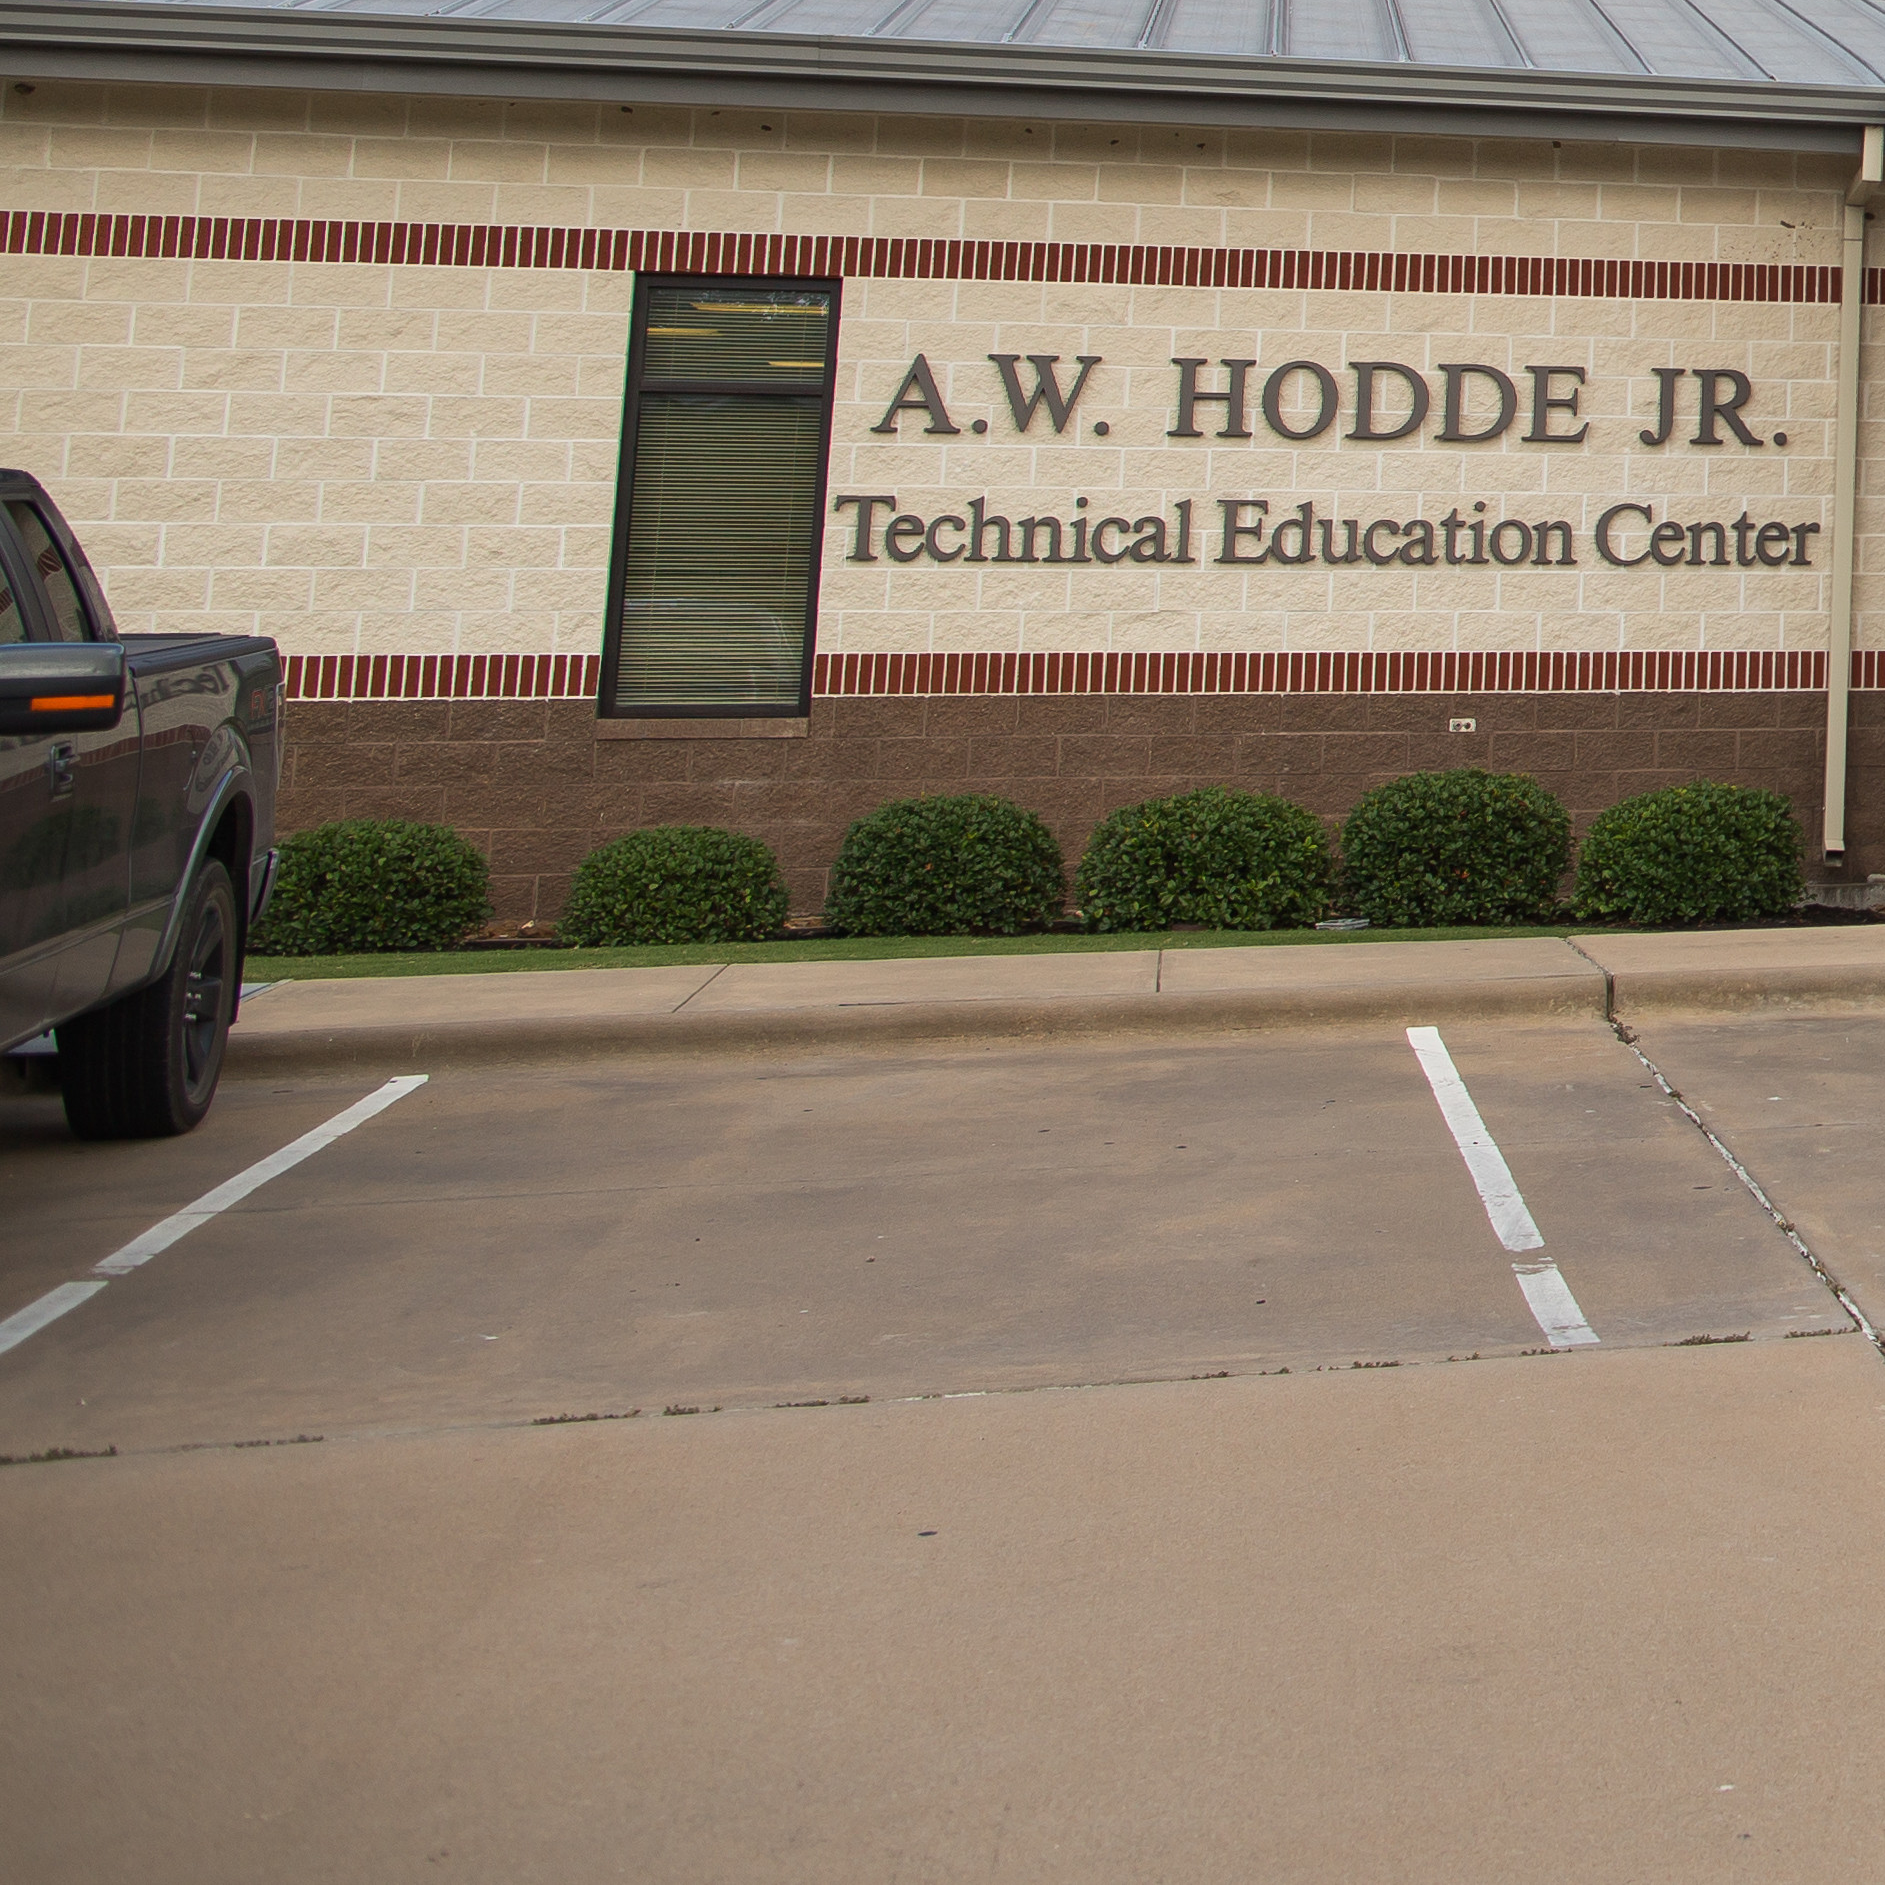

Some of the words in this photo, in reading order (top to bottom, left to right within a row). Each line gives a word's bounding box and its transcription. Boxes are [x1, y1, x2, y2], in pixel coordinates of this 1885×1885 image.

[869, 353, 1111, 437] A.W.
[1165, 357, 1591, 445] HODDE
[1639, 367, 1789, 448] JR.
[833, 494, 1197, 565] Technical
[1213, 499, 1579, 567] Education
[1594, 502, 1822, 569] Center
